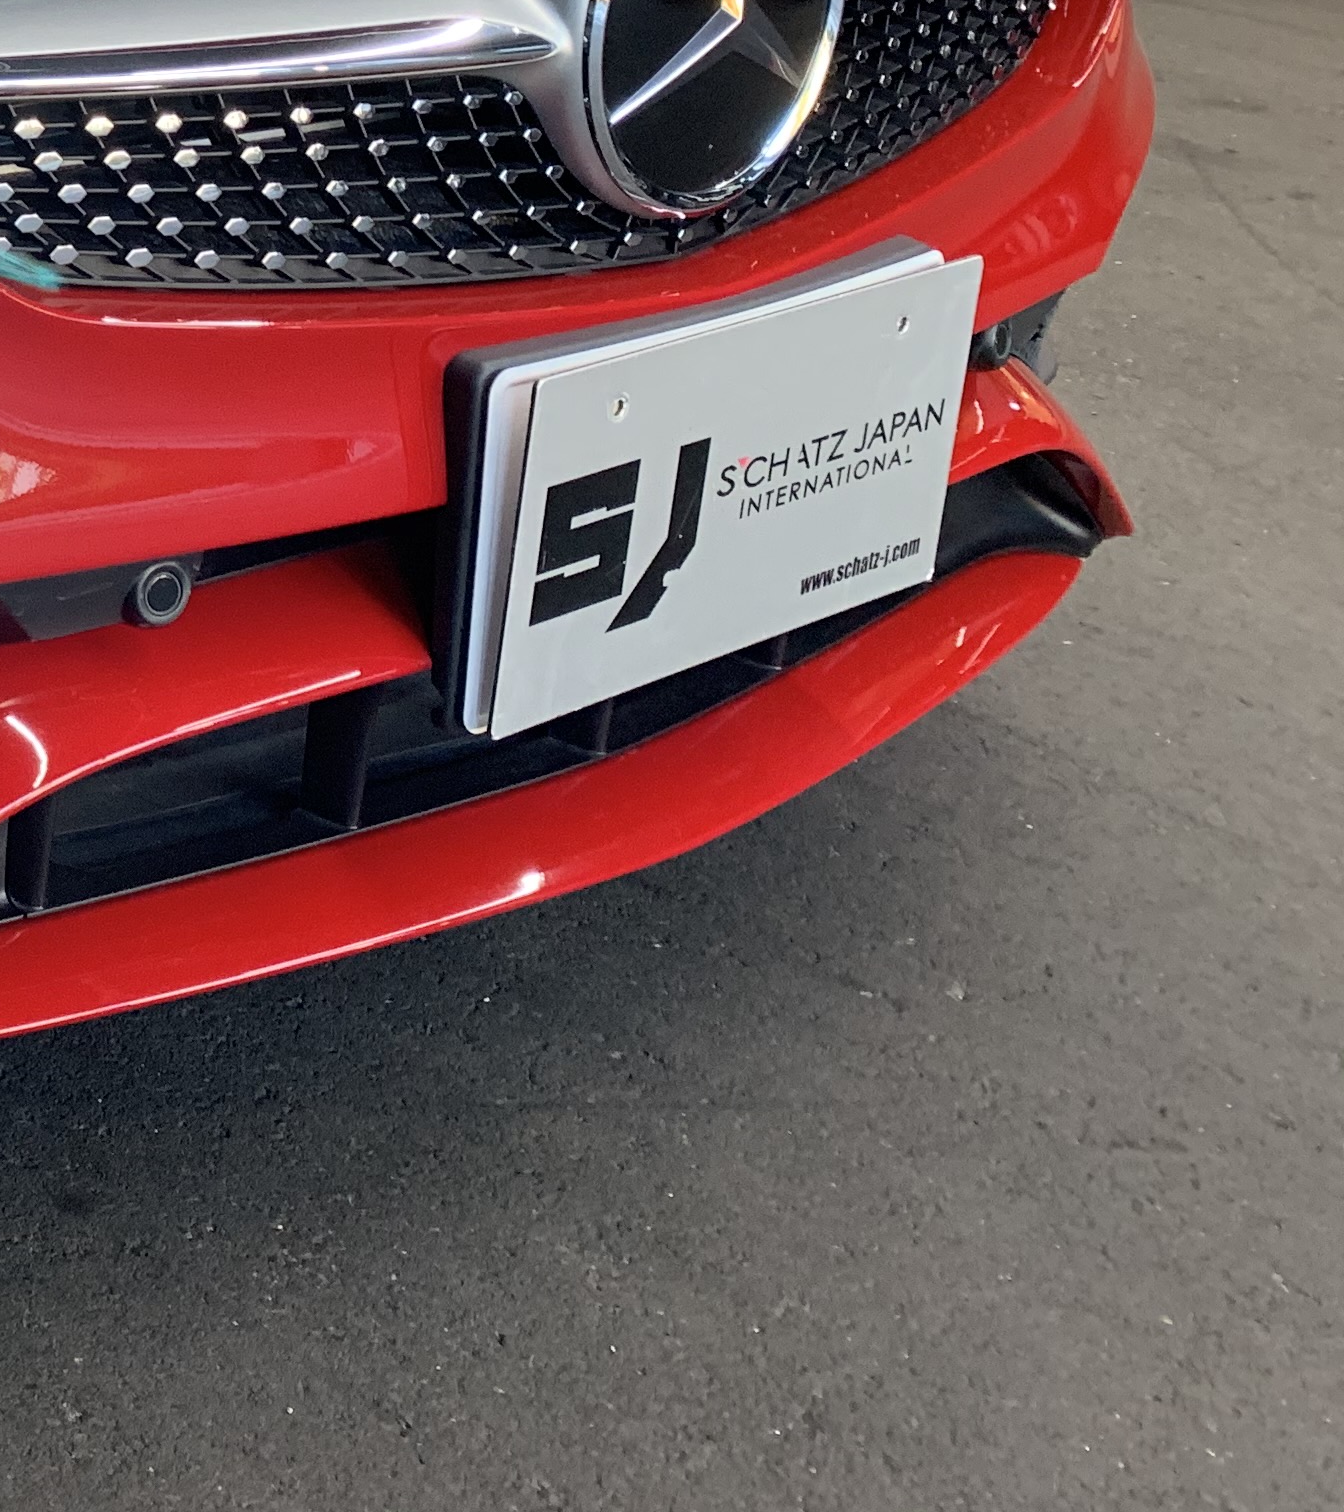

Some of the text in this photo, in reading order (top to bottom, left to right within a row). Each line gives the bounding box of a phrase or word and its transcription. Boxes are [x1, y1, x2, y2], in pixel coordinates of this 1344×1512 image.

[716, 398, 946, 497] SCHATZ JAPAN
[739, 444, 913, 519] INTERNATIONAL
[800, 537, 921, 595] www.schatz-j.com
